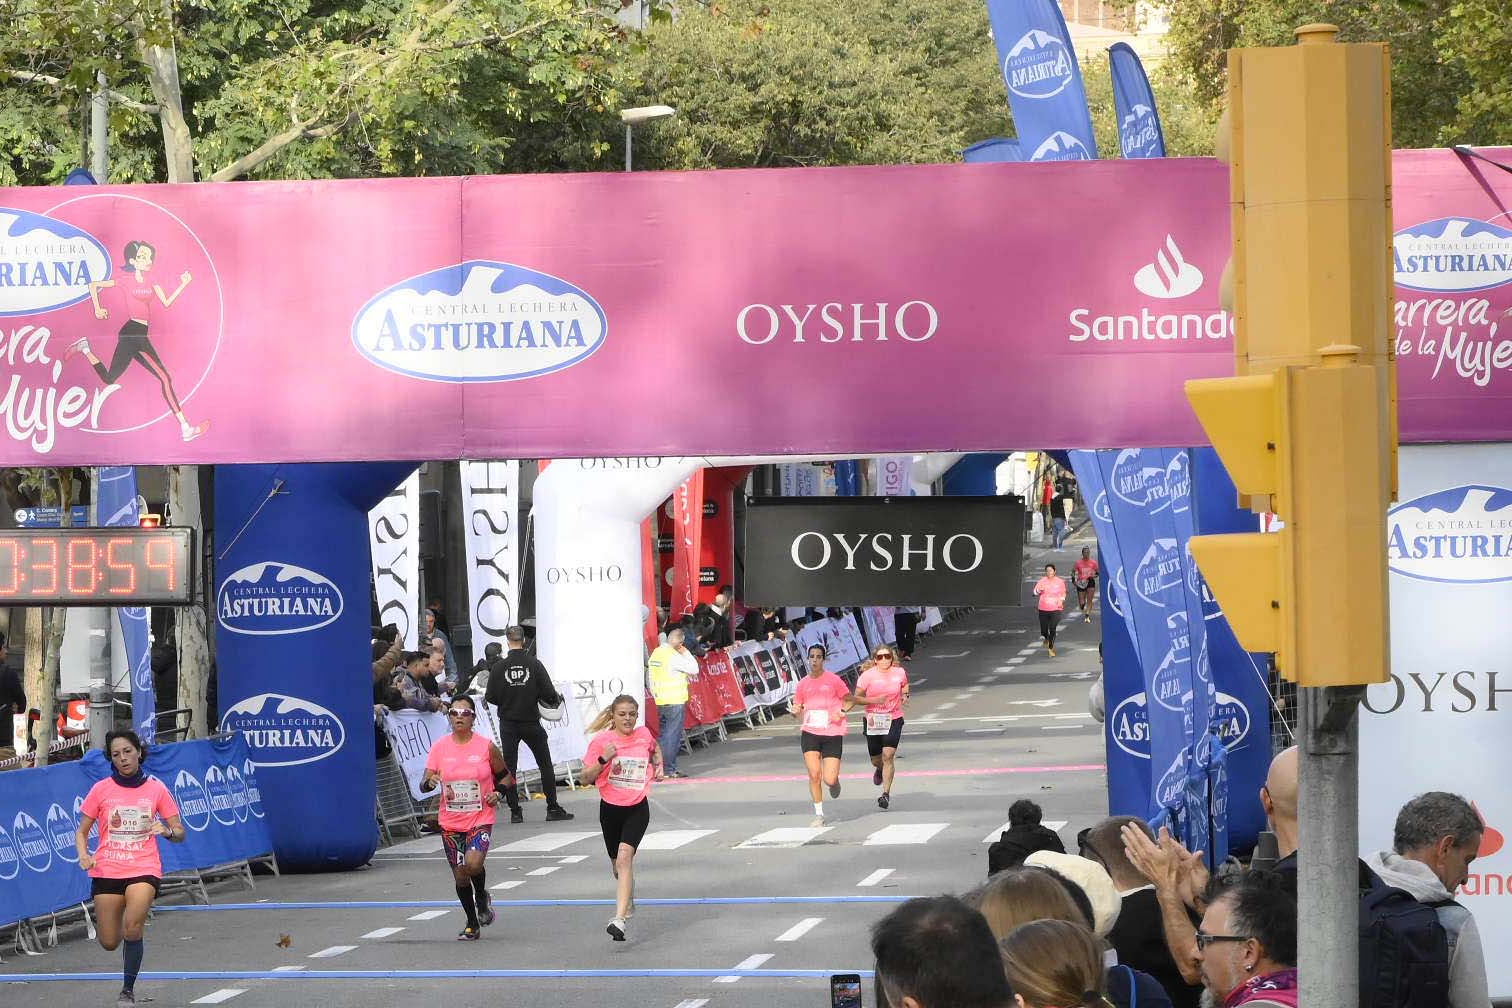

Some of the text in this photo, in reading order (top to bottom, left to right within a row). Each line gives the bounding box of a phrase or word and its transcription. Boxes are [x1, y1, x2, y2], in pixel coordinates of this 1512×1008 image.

[15, 243, 87, 256] LECHERA
[1408, 242, 1458, 251] CENTRAL
[409, 300, 580, 315] CENTRAL LECHERA
[1394, 297, 1490, 327] arrera
[372, 306, 587, 353] ASTURIANA
[736, 300, 939, 346] OYSHO
[1418, 329, 1435, 356] la
[1416, 519, 1482, 530] CENTRAL
[791, 531, 984, 573] OYSHO
[547, 564, 622, 585] OYSHO
[233, 586, 329, 596] CENTRAL LECHERA
[221, 592, 334, 618] ASTURIANA
[511, 670, 524, 680] BP
[235, 717, 330, 727] CENTRAL LECHERA
[221, 723, 335, 748] TURIANA
